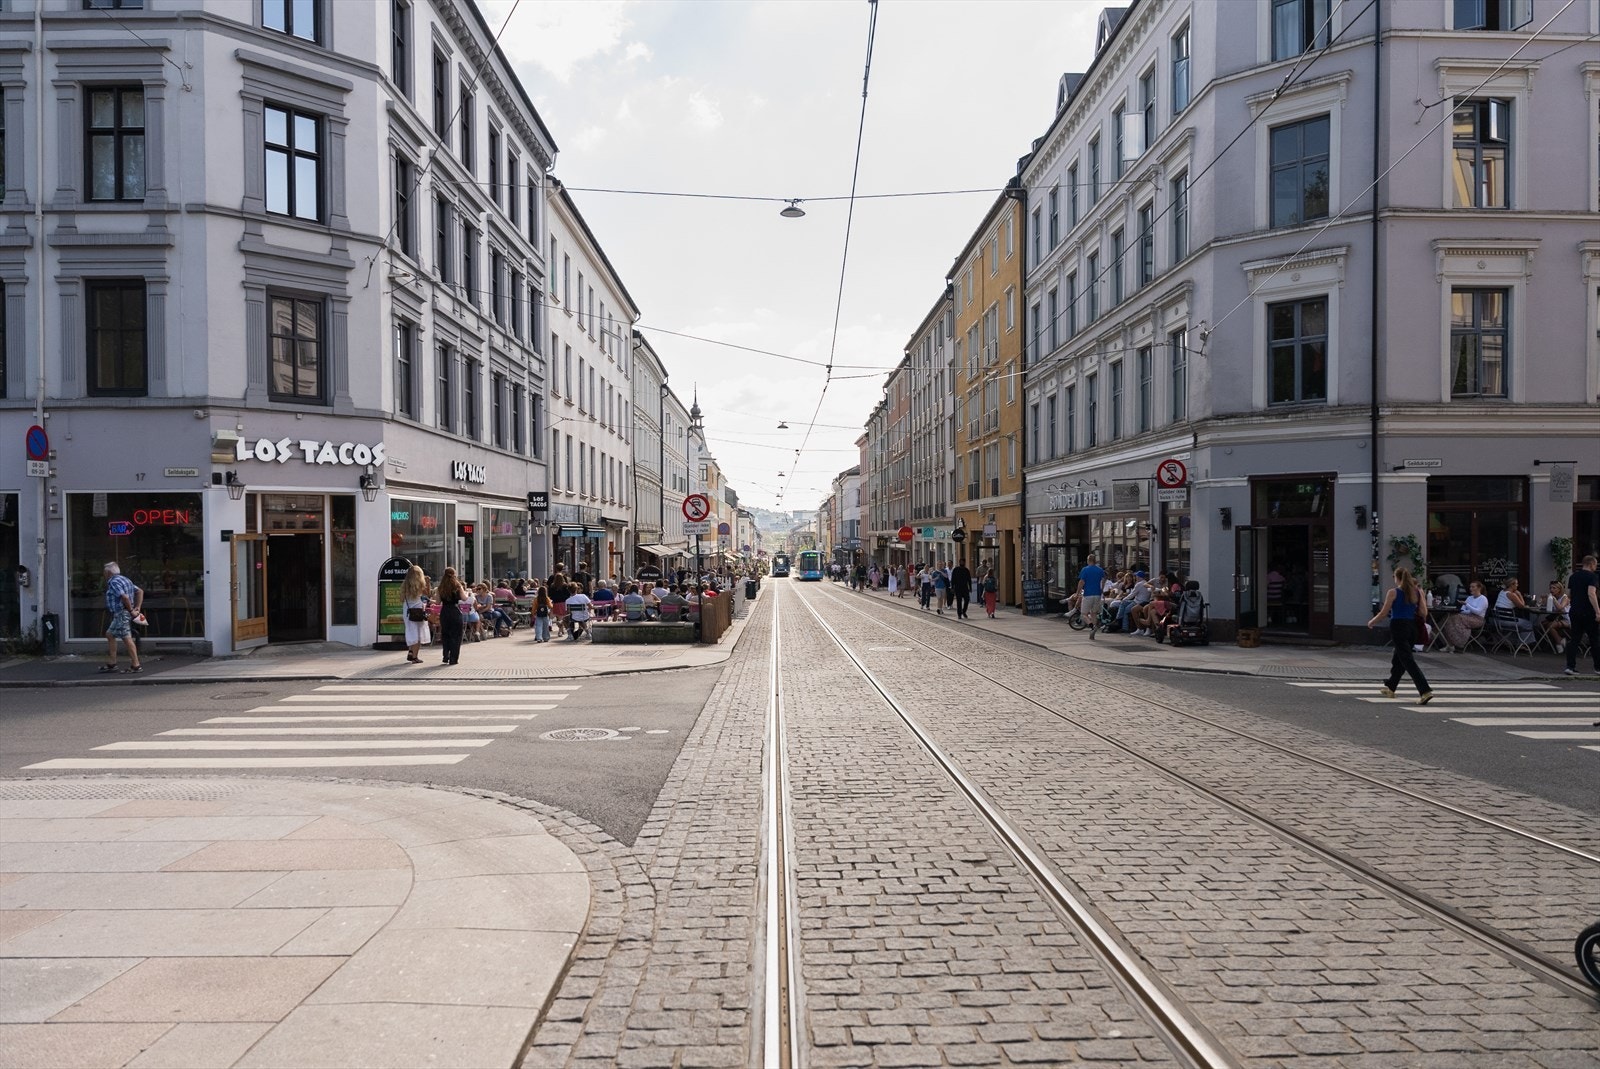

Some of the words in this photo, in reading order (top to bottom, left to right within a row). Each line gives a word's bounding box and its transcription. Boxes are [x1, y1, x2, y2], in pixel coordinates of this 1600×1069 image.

[235, 436, 293, 464] LOS
[298, 440, 386, 468] TACOS
[135, 472, 146, 481] 17
[454, 460, 467, 481] LOS
[467, 463, 486, 484] TACOS
[133, 509, 189, 525] OPEN
[111, 524, 127, 534] BAR
